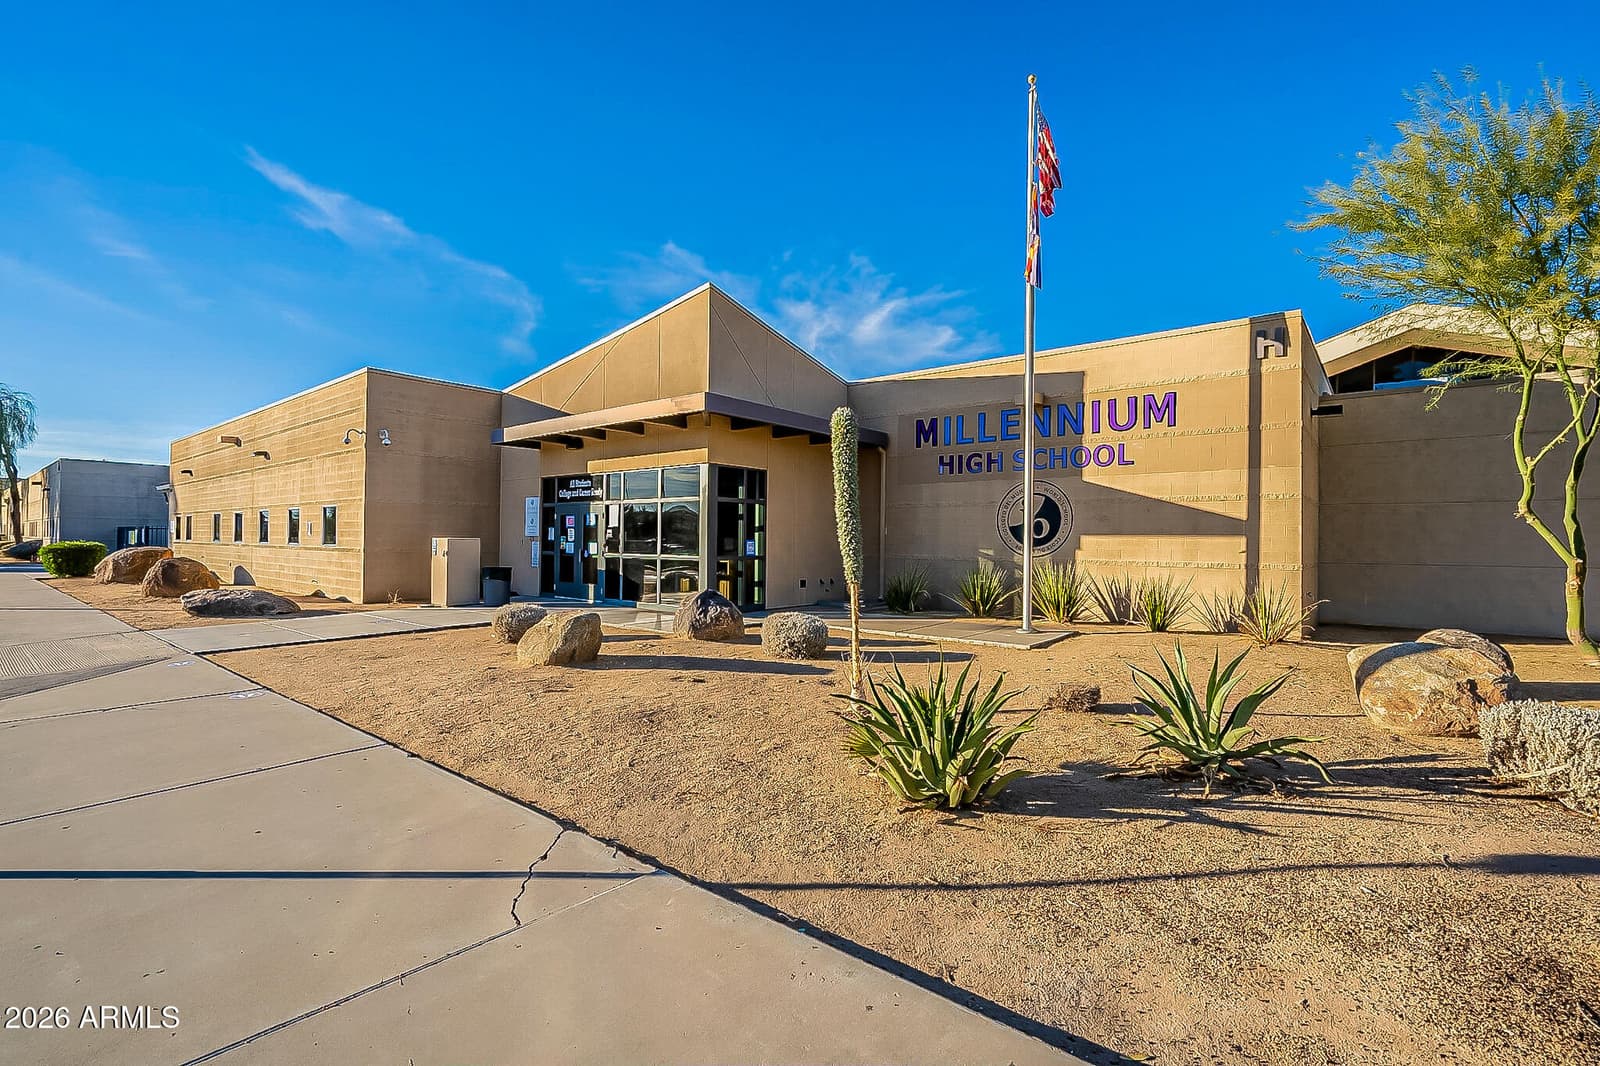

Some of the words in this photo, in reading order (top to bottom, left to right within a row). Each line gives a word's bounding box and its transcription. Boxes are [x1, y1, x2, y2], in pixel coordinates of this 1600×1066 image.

[915, 391, 1177, 448] MILLENNIUM
[938, 451, 1003, 475] HIGH
[1012, 443, 1134, 471] SCHOOL
